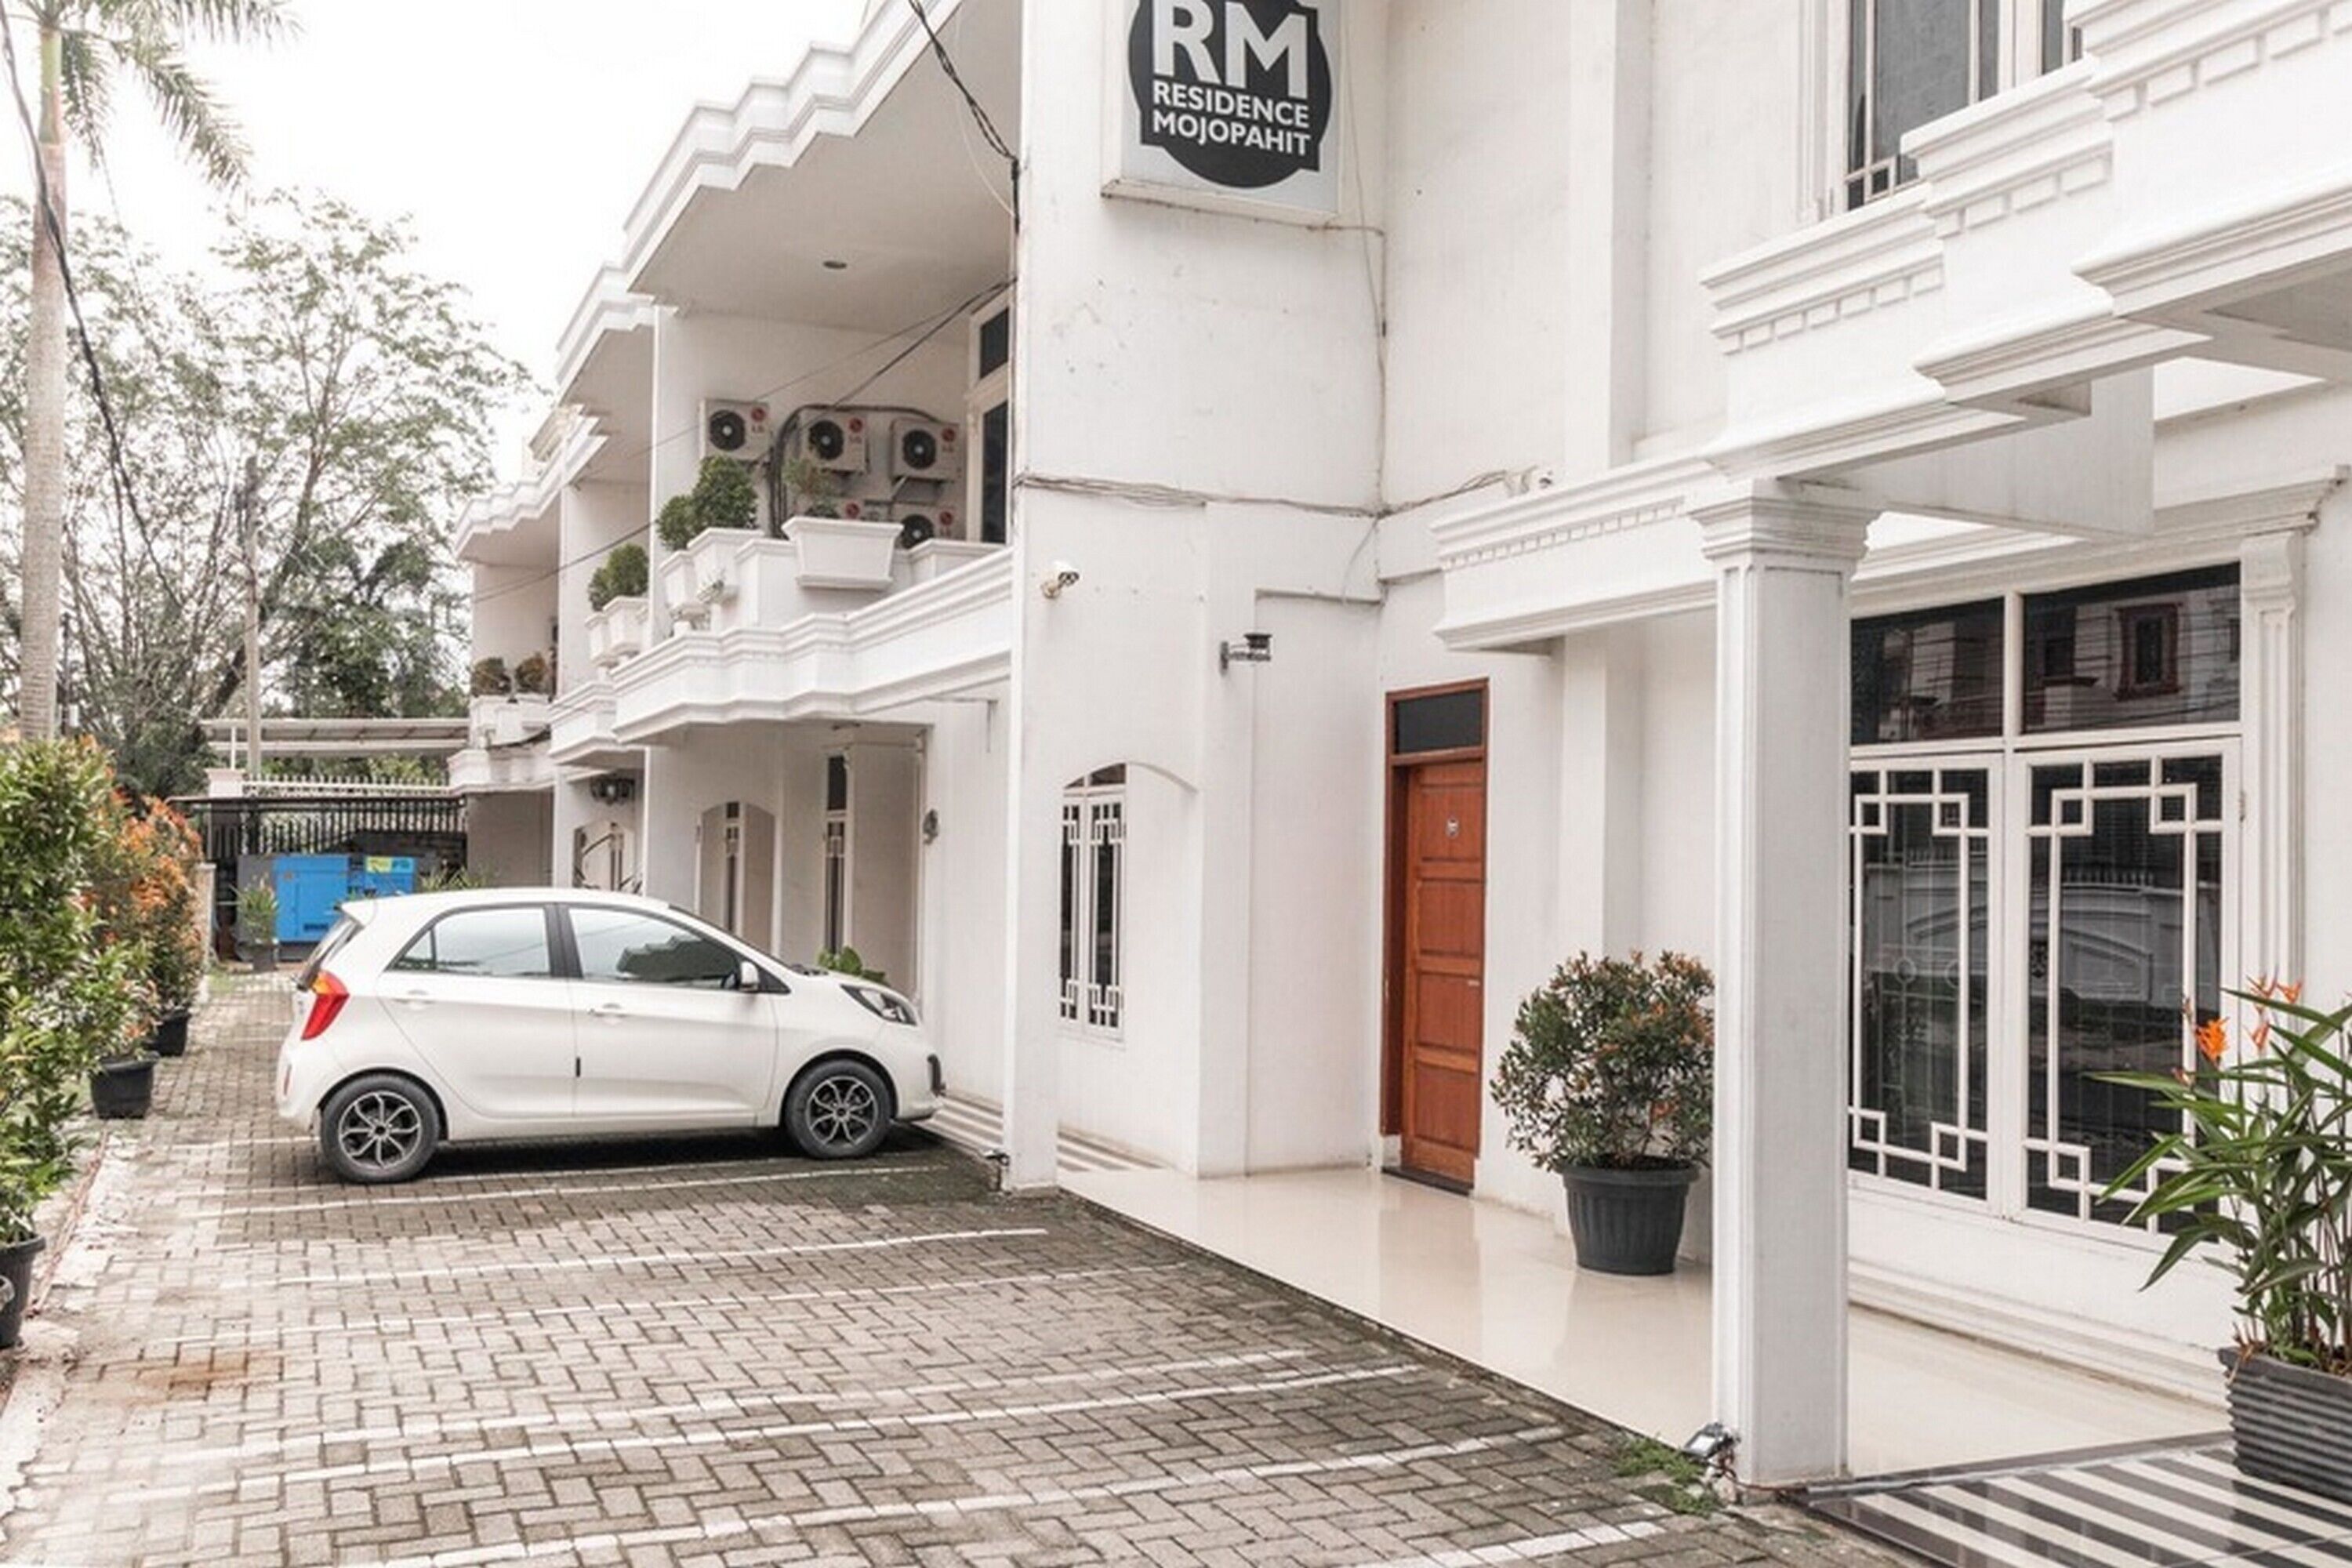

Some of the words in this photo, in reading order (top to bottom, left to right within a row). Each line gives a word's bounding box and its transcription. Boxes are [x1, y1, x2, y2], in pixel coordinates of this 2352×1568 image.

[1153, 0, 1308, 100] RM
[1153, 80, 1309, 129] RESIDENCE
[1153, 109, 1311, 155] MOJOPAHIT
